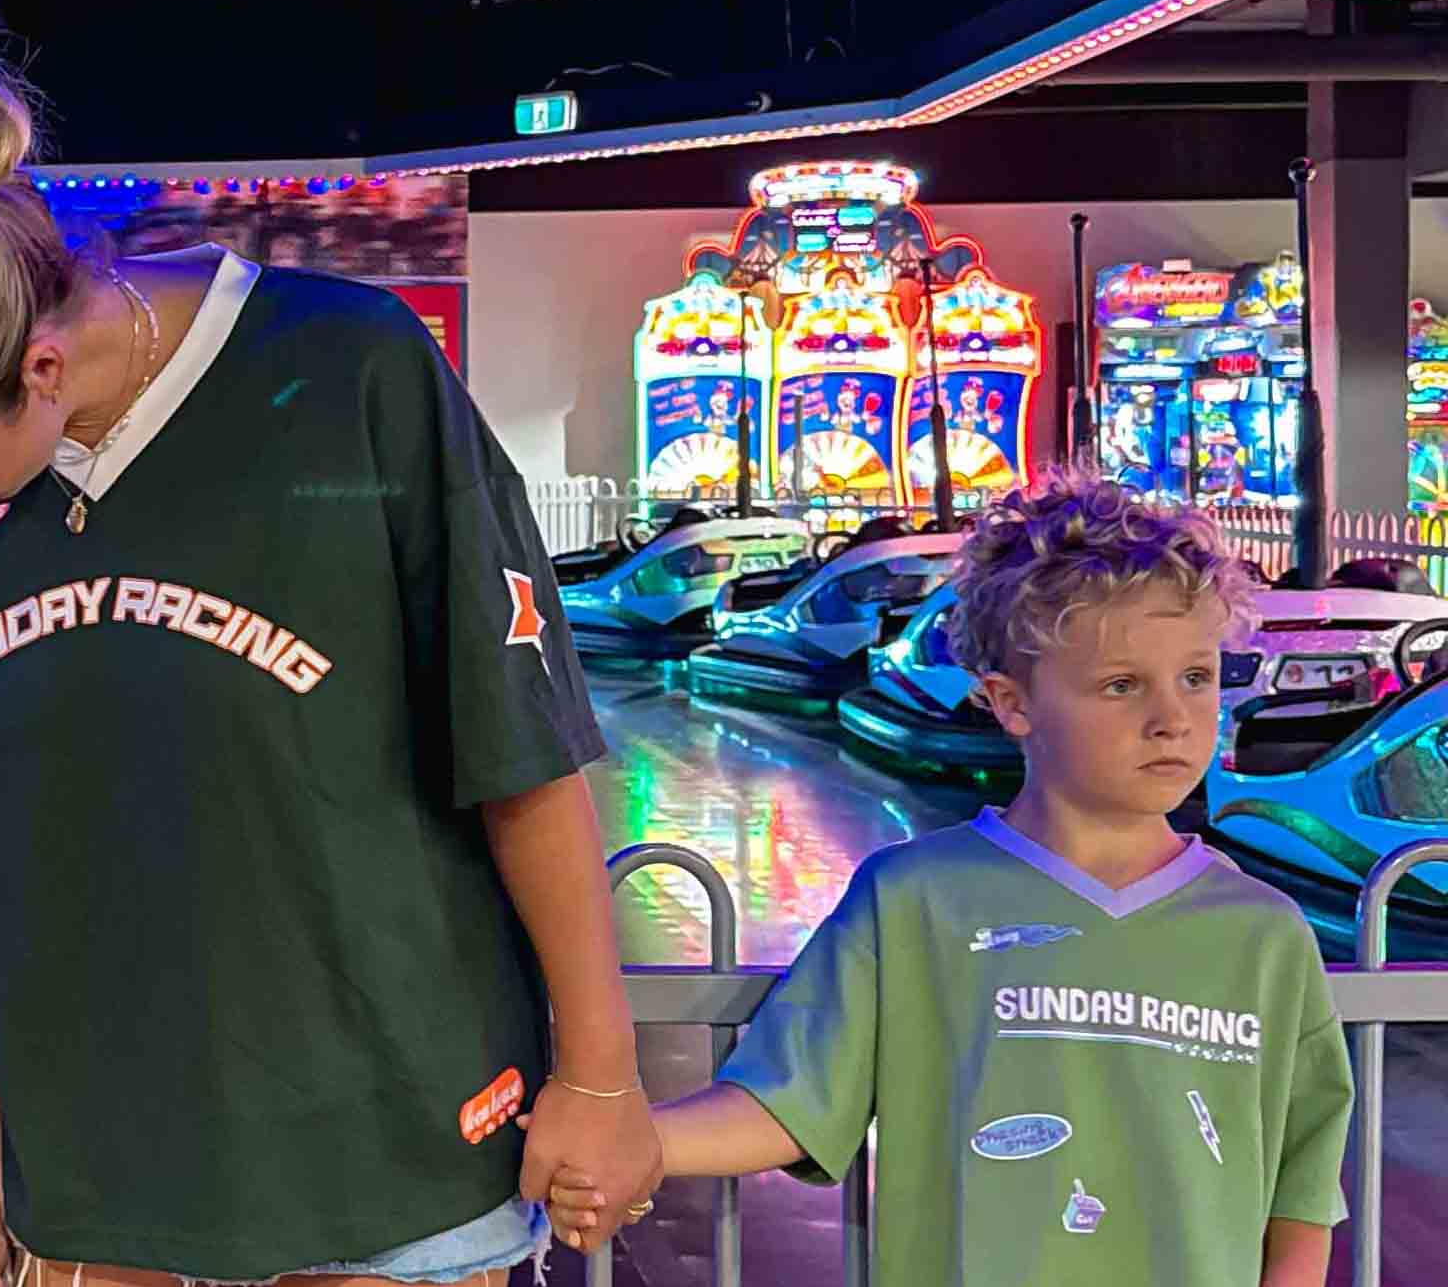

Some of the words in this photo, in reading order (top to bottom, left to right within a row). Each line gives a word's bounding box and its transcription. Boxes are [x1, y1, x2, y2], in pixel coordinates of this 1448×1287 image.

[111, 575, 333, 695] RACING
[994, 985, 1135, 1026] SUNDAY
[1140, 995, 1261, 1049] RACING
